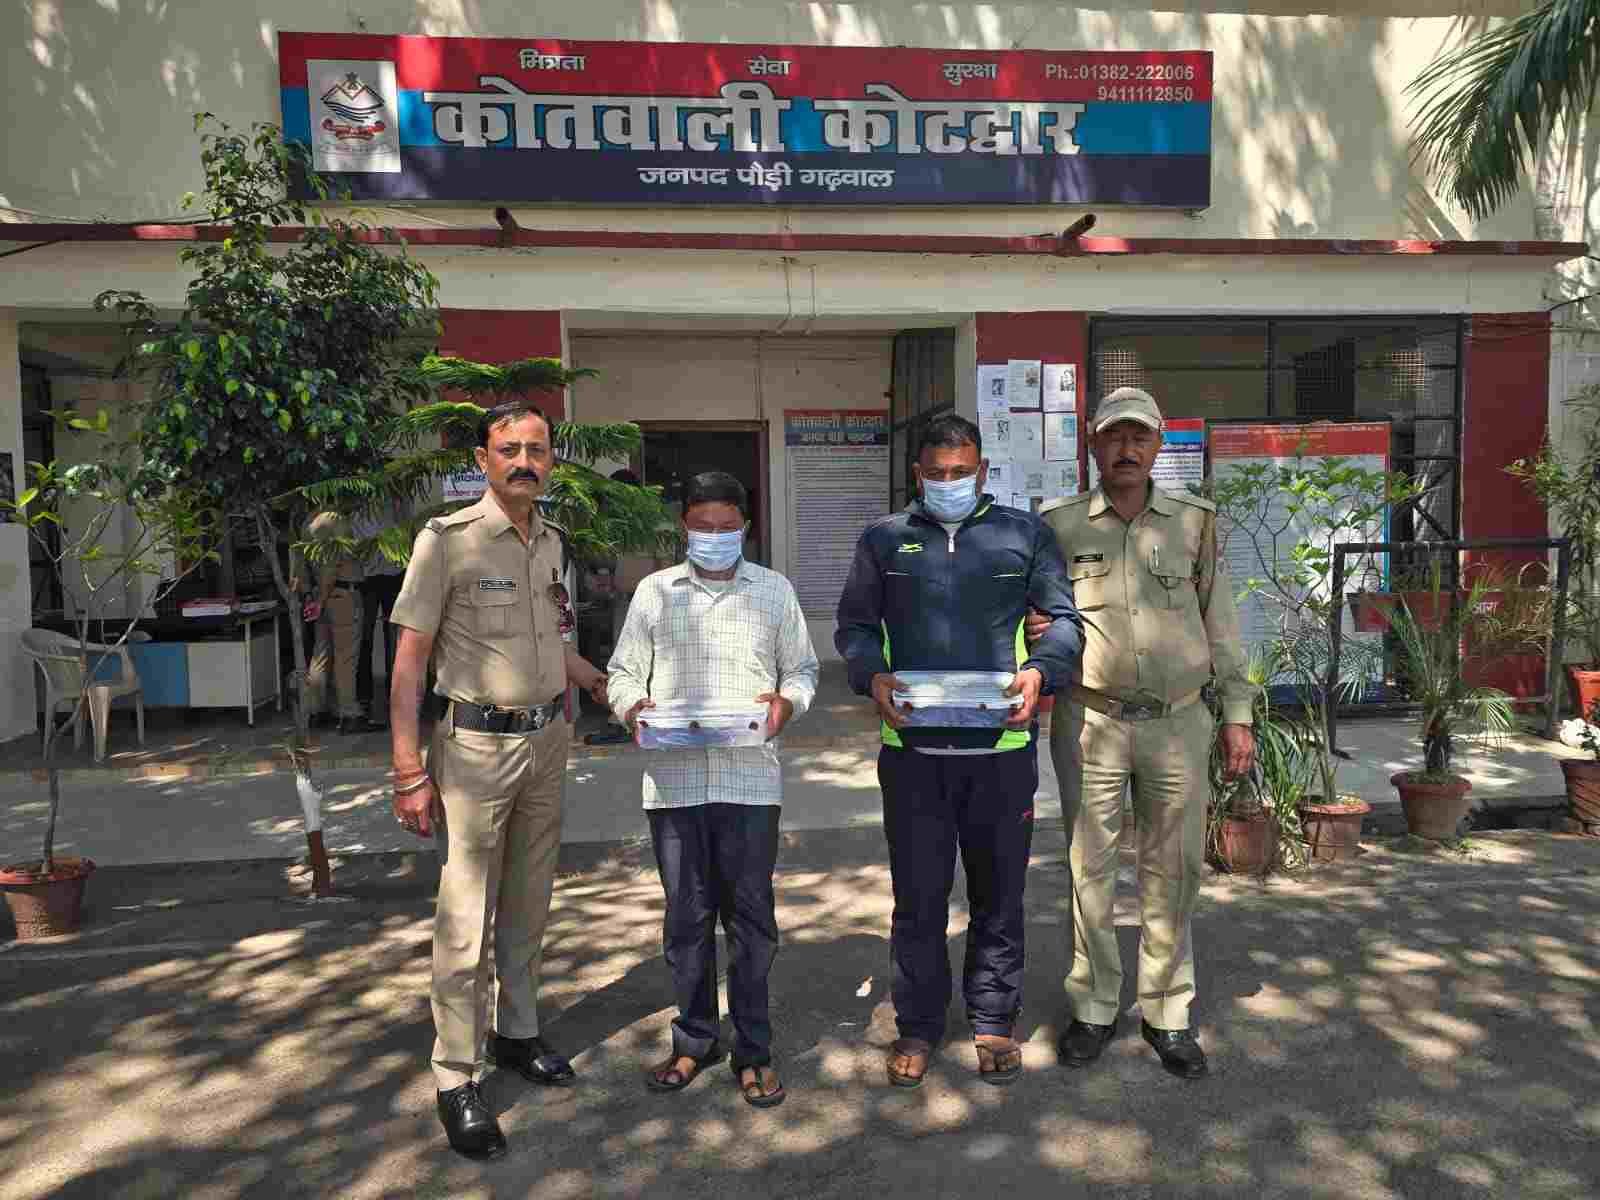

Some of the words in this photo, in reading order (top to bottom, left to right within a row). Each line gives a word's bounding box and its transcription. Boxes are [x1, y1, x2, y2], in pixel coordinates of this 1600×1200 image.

[519, 48, 586, 70] मित्रता
[745, 55, 792, 76] सेवा
[942, 63, 998, 86] सुरक्षा
[1045, 63, 1195, 81] Ph.:01382-222006
[1097, 85, 1194, 102] 9411112850
[423, 75, 791, 153] कोतवाली
[813, 82, 1086, 156] कोटद्वार
[637, 167, 730, 186] जनपद
[735, 161, 793, 191] पौड़ी
[799, 168, 896, 191] गढ़वाल
